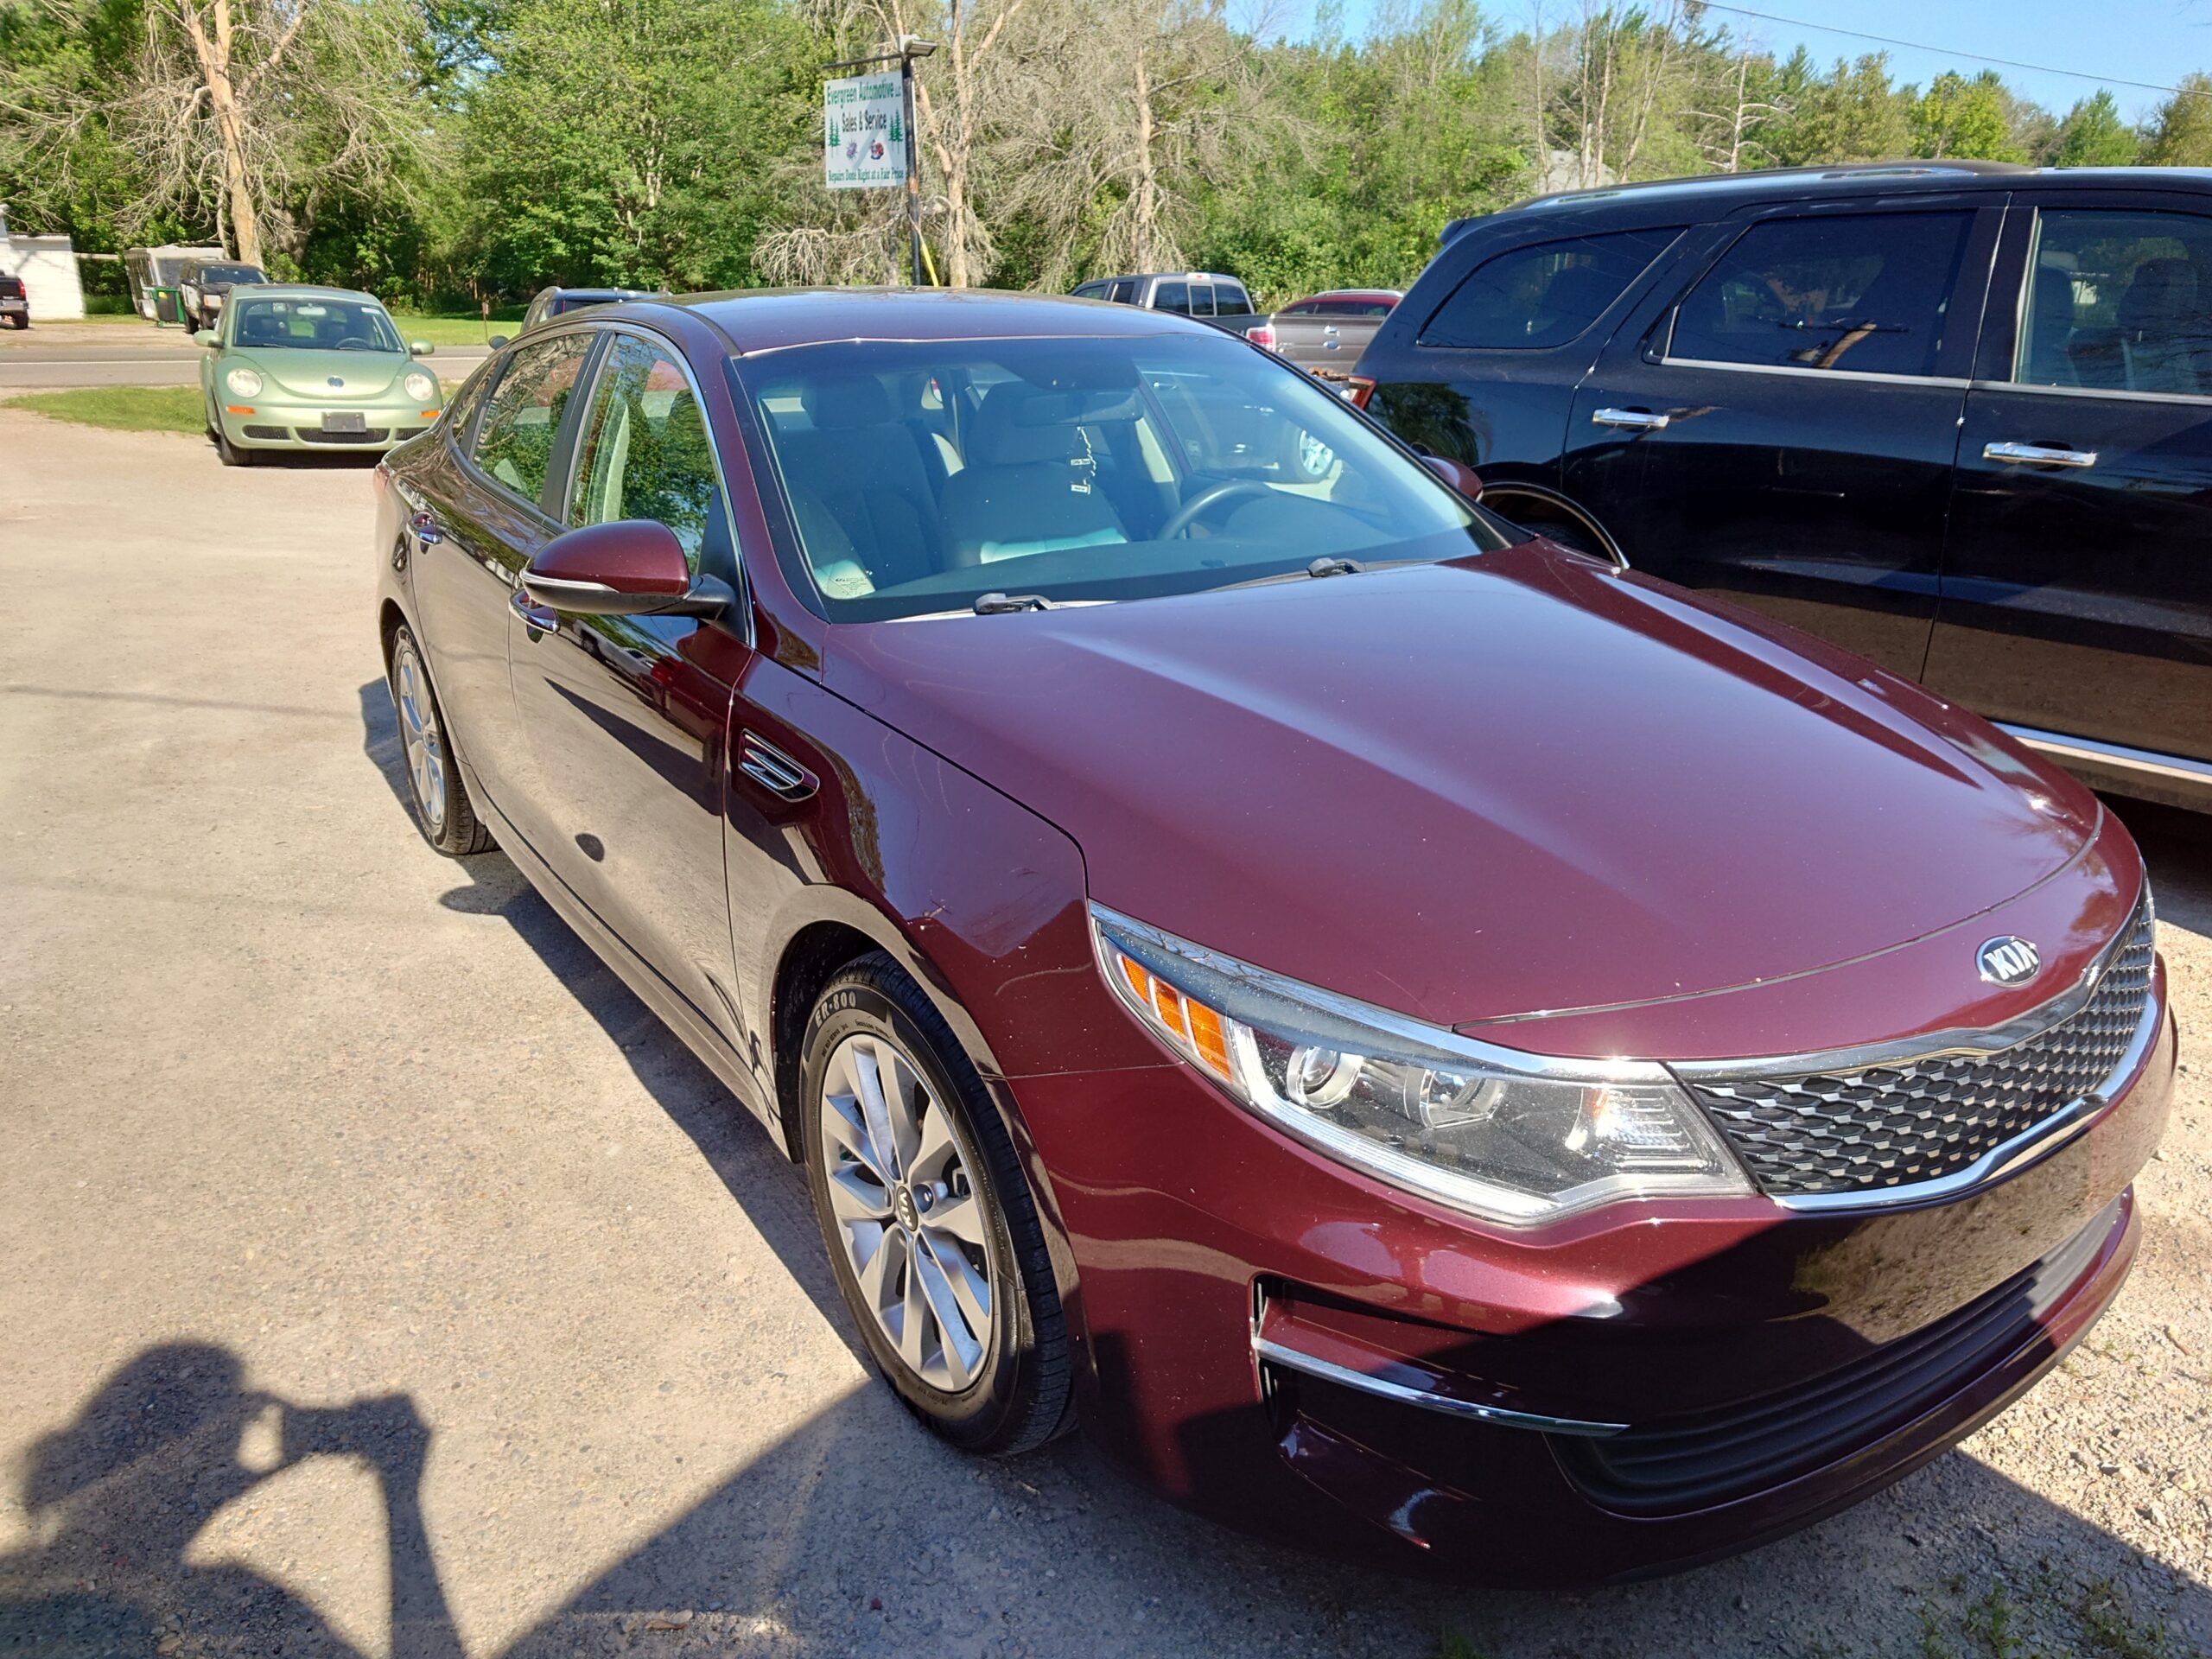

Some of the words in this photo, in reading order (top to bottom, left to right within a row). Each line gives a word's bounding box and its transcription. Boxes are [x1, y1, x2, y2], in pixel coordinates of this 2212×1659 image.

[827, 85, 857, 109] Evergreen
[859, 79, 894, 101] Automotive
[842, 111, 857, 132] Sales
[865, 109, 887, 130] Service
[1983, 941, 2039, 980] KIA
[815, 991, 856, 1028] ER-800
[899, 1192, 913, 1227] KIA
